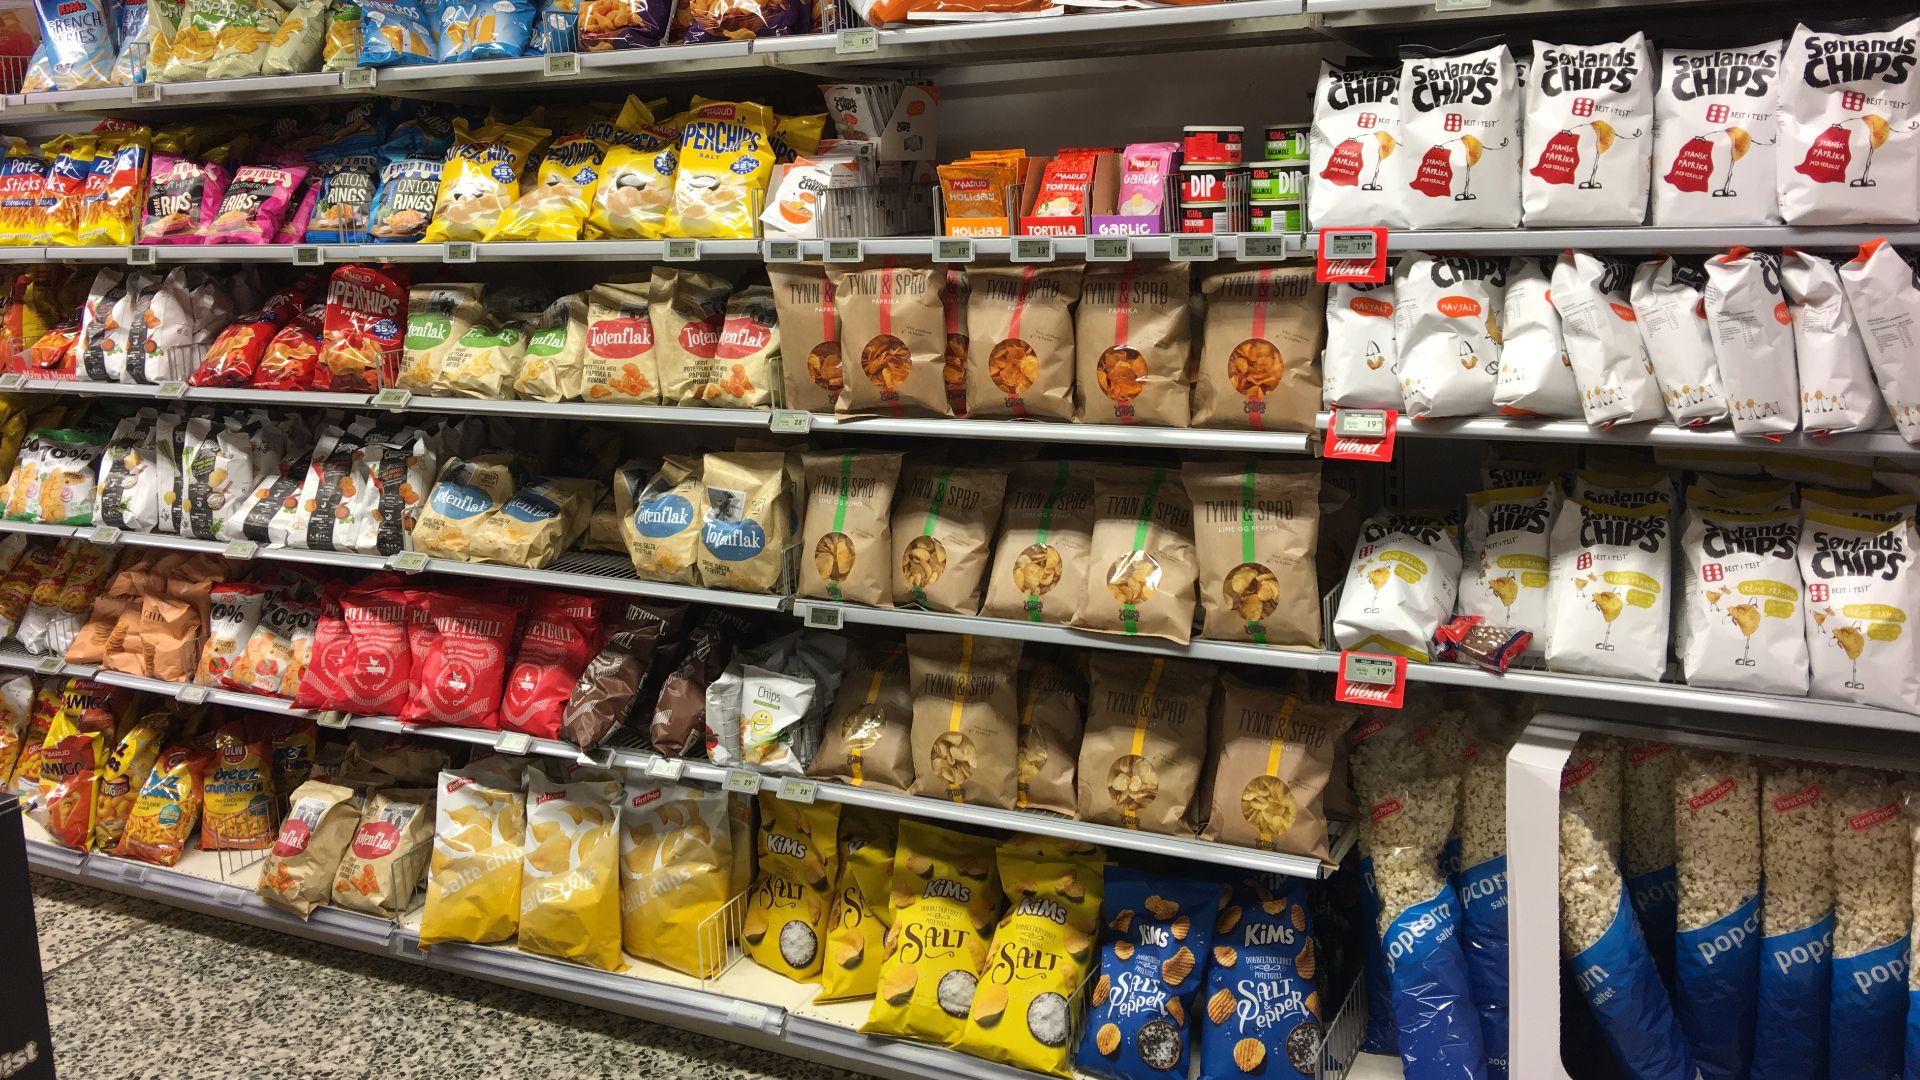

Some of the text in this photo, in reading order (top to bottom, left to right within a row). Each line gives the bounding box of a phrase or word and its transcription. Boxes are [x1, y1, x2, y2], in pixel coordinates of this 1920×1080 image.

[1543, 48, 1636, 71] Sørlands
[1805, 36, 1917, 60] Sørlands
[1412, 58, 1497, 86] Sørlands
[1673, 50, 1776, 73] Sørlands
[1803, 52, 1917, 88] CHIPS
[1541, 66, 1638, 97] CHIPS
[1672, 66, 1776, 101] CHIPS
[1412, 75, 1498, 113] CHIPS
[1866, 97, 1882, 106] BEST
[1595, 105, 1631, 117] BEST TEST
[1463, 119, 1477, 127] BEST
[699, 152, 720, 160] SALT
[1332, 157, 1359, 168] PAPRIKA
[1545, 152, 1574, 164] PAPRIKA
[1678, 159, 1708, 171] PAPRIKA
[1812, 149, 1845, 161] PAPRIKA
[329, 172, 371, 187] ONION
[1053, 172, 1087, 181] MAARUD
[1422, 166, 1448, 178] PAPRIKA
[3, 176, 40, 192] Sticks
[327, 187, 367, 204] RINGS
[397, 179, 440, 195] ONION
[953, 179, 988, 190] MAARUD
[1190, 173, 1216, 198] DIP
[225, 192, 258, 212] RIBS
[392, 193, 434, 211] RINGS
[790, 282, 833, 304] TYNN &
[849, 274, 925, 296] TYNN & SPRØ
[987, 279, 1016, 301] TYNN
[1085, 281, 1168, 305] TYNN SPRØ
[1220, 275, 1309, 298] TYNN & SPRØ
[1353, 301, 1391, 313] HAVSALT
[1441, 303, 1478, 312] HAVSALT
[590, 326, 651, 346] Totenflak
[683, 326, 718, 348] Toten
[1333, 438, 1384, 455] Tilbud
[433, 486, 487, 513] Totenflak
[1205, 499, 1294, 523] TYNN & SPRØ
[1107, 496, 1190, 528] TYNN SPRØ
[705, 522, 761, 549] Totenflak
[1580, 519, 1666, 554] CHIPS
[1702, 529, 1798, 560] CHIPS
[1724, 562, 1761, 573] BEST TEST
[1811, 549, 1907, 581] CHIPS
[1853, 585, 1869, 593] TEST
[758, 685, 781, 703] Chips
[925, 673, 951, 695] TYNN
[957, 676, 967, 696] &
[1106, 691, 1187, 725] TYNN & SPRØ
[1239, 708, 1328, 749] TYNN & SPRØ
[634, 790, 661, 805] First Price
[1692, 781, 1734, 808] First Price
[1776, 788, 1818, 811] First Price
[1380, 802, 1398, 814] Price
[1853, 806, 1897, 829] First Price
[354, 829, 395, 851] Totenflak
[767, 833, 806, 859] KiMs
[440, 865, 482, 896] salte
[650, 866, 692, 898] chips
[923, 879, 971, 904] KiMs
[521, 887, 552, 915] salte
[1017, 898, 1068, 926] KiMs
[900, 922, 970, 965] SALT
[1138, 923, 1169, 948] KiMs
[1244, 923, 1295, 948] KiMs
[991, 942, 1063, 986] SALT
[1254, 971, 1283, 980] POTETGULL
[1116, 971, 1160, 996] SALT
[1237, 978, 1294, 1006] SALT
[1263, 1001, 1272, 1011] &
